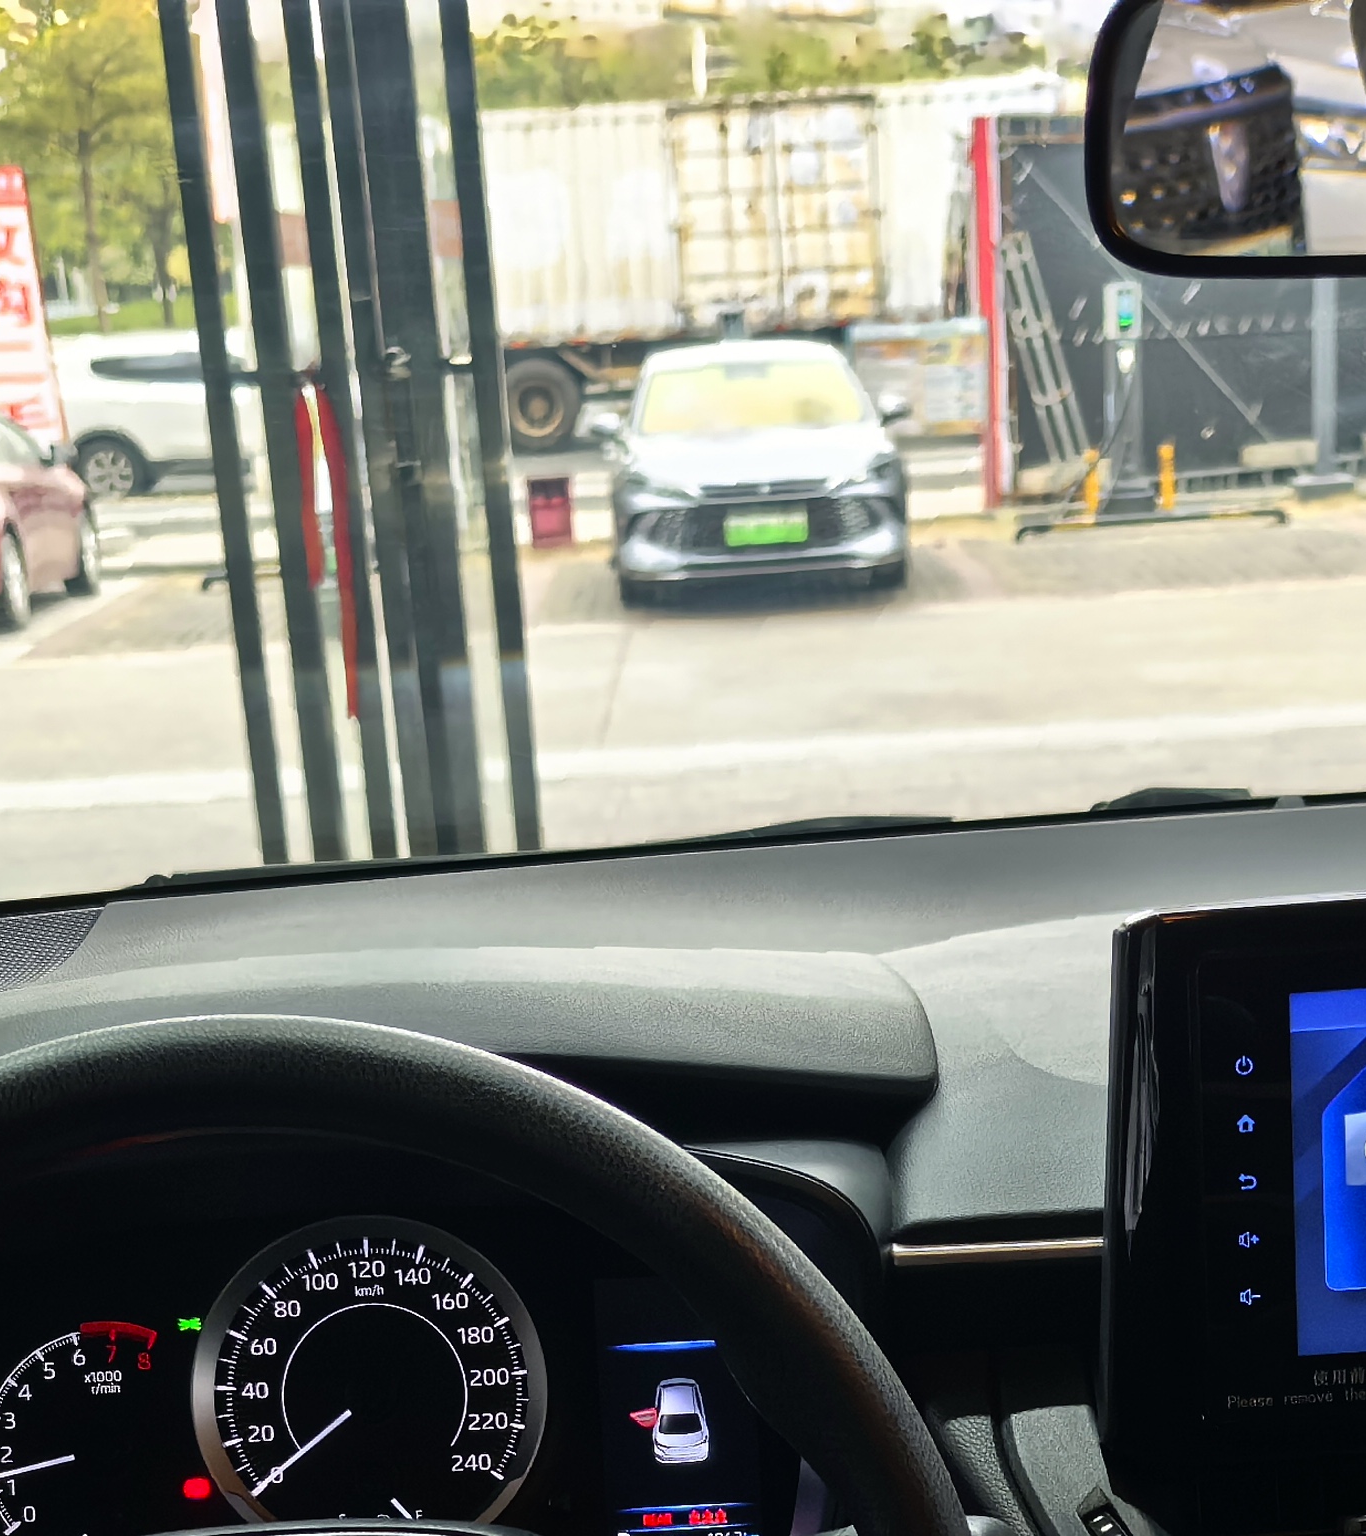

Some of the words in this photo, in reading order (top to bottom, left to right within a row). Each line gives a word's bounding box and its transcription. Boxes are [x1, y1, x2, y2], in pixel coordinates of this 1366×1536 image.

[348, 1260, 385, 1278] 120
[393, 1267, 432, 1285] 140
[301, 1272, 339, 1291] 100
[354, 1284, 385, 1297] km/h
[274, 1301, 301, 1318] 80
[432, 1292, 469, 1310] 160
[457, 1326, 494, 1344] 180
[250, 1338, 277, 1356] 60
[72, 1349, 86, 1367] 6
[137, 1352, 152, 1371] 8
[43, 1361, 56, 1379] 5
[470, 1368, 510, 1387] 200
[17, 1384, 33, 1401] 4
[241, 1381, 269, 1399] 40
[1226, 1394, 1275, 1409] Please
[1283, 1391, 1334, 1406] remove
[1345, 1386, 1366, 1401] the
[3, 1412, 17, 1430] 3
[468, 1412, 509, 1431] 220
[247, 1425, 274, 1443] 20
[0, 1446, 14, 1464] 2
[451, 1453, 492, 1472] 240
[6, 1479, 16, 1496] 1
[23, 1505, 36, 1522] 0
